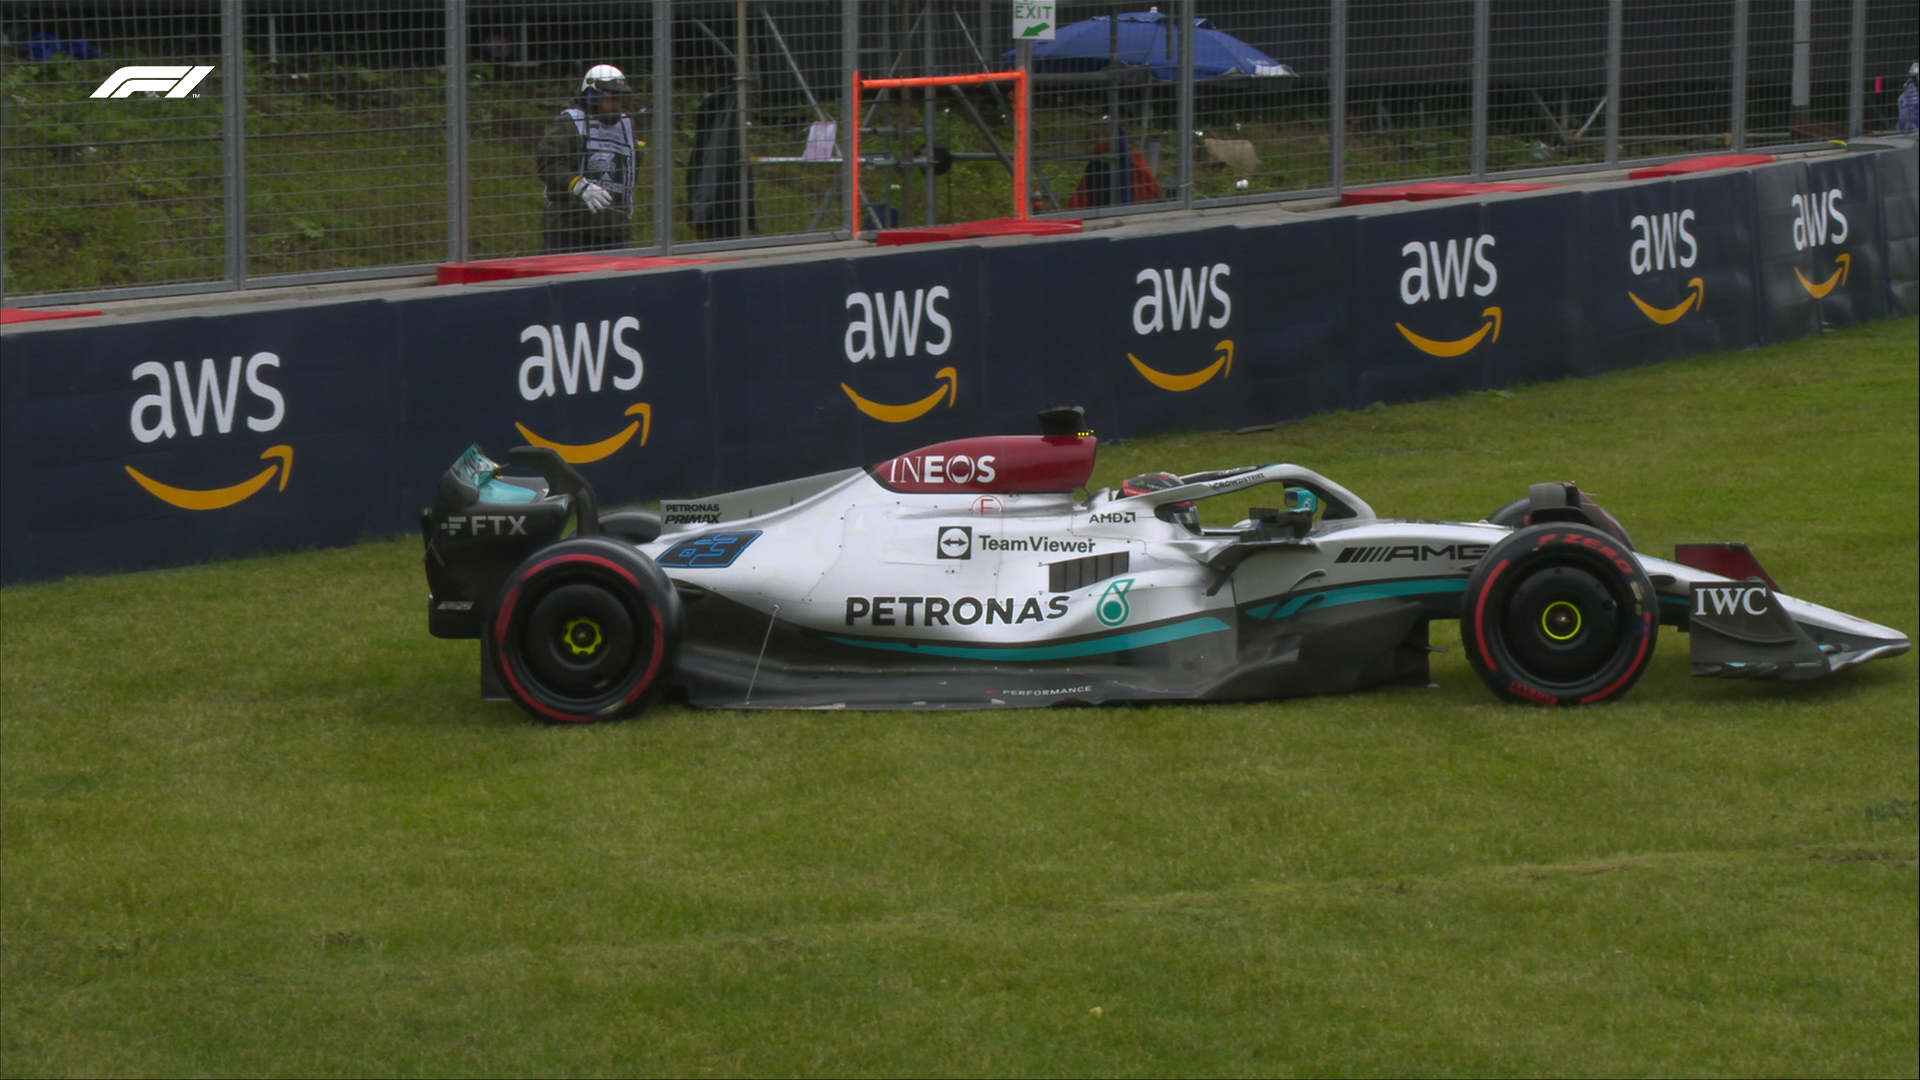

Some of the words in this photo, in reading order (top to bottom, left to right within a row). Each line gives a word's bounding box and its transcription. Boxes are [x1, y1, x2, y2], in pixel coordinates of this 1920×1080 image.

[1015, 5, 1053, 20] EXIT
[1791, 188, 1850, 252] aws
[1630, 208, 1698, 276] aws
[1400, 233, 1498, 305] aws
[1132, 262, 1232, 335] aws
[844, 285, 952, 364] aws
[518, 315, 644, 402] aws
[130, 351, 286, 443] aws
[888, 455, 996, 484] INEOS
[664, 512, 722, 525] PRIMAX
[665, 503, 720, 513] PETRONAS
[1089, 512, 1123, 523] AMD
[471, 515, 528, 536] FTX
[654, 530, 764, 569] 63
[979, 535, 1096, 553] TeamViewer
[1383, 544, 1491, 562] AMG
[1561, 532, 1635, 575] ZERO
[845, 595, 1071, 627] PETRONAS
[1694, 587, 1768, 616] IWC
[1002, 685, 1093, 697] PERFORMANCE
